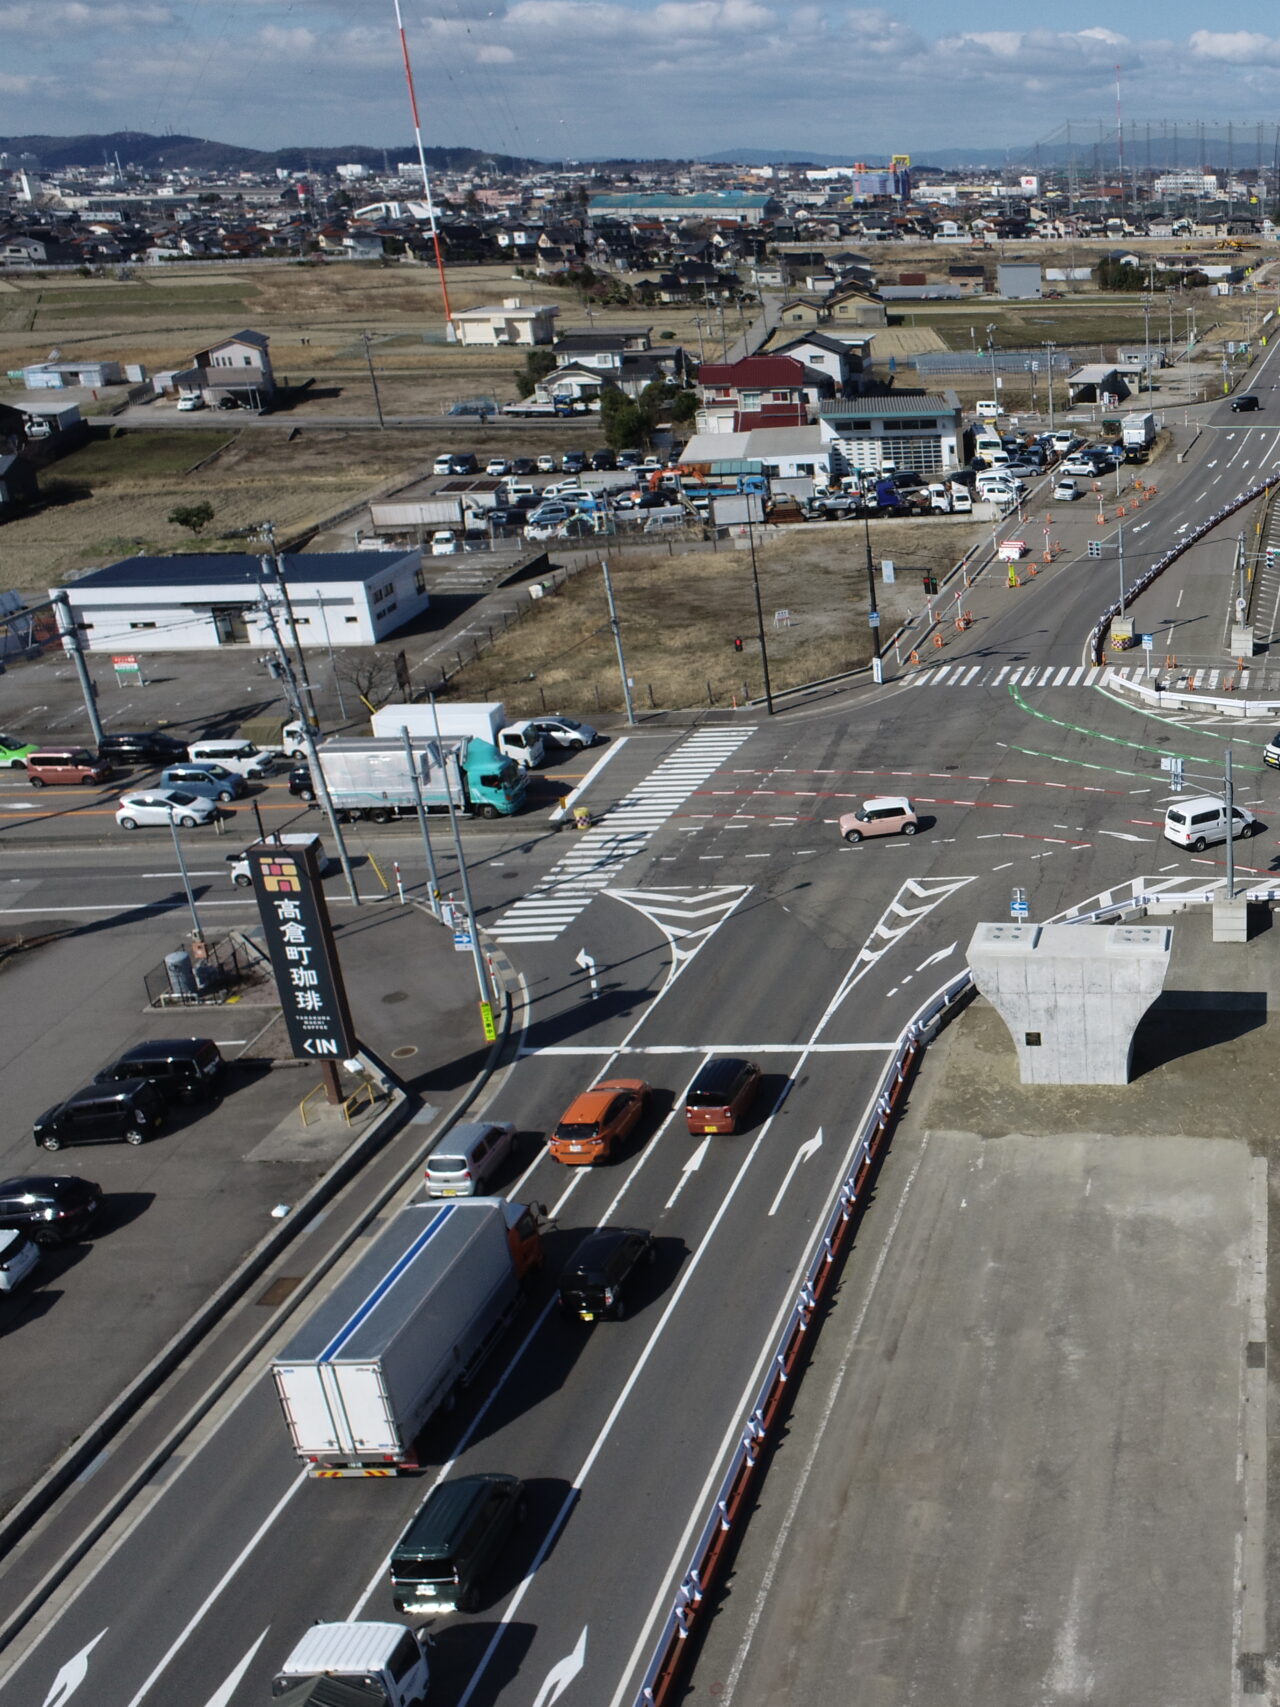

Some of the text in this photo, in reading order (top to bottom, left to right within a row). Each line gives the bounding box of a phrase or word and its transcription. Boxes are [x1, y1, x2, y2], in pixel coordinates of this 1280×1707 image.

[273, 898, 323, 1011] 高倉町珈琲
[315, 1038, 338, 1054] IN
